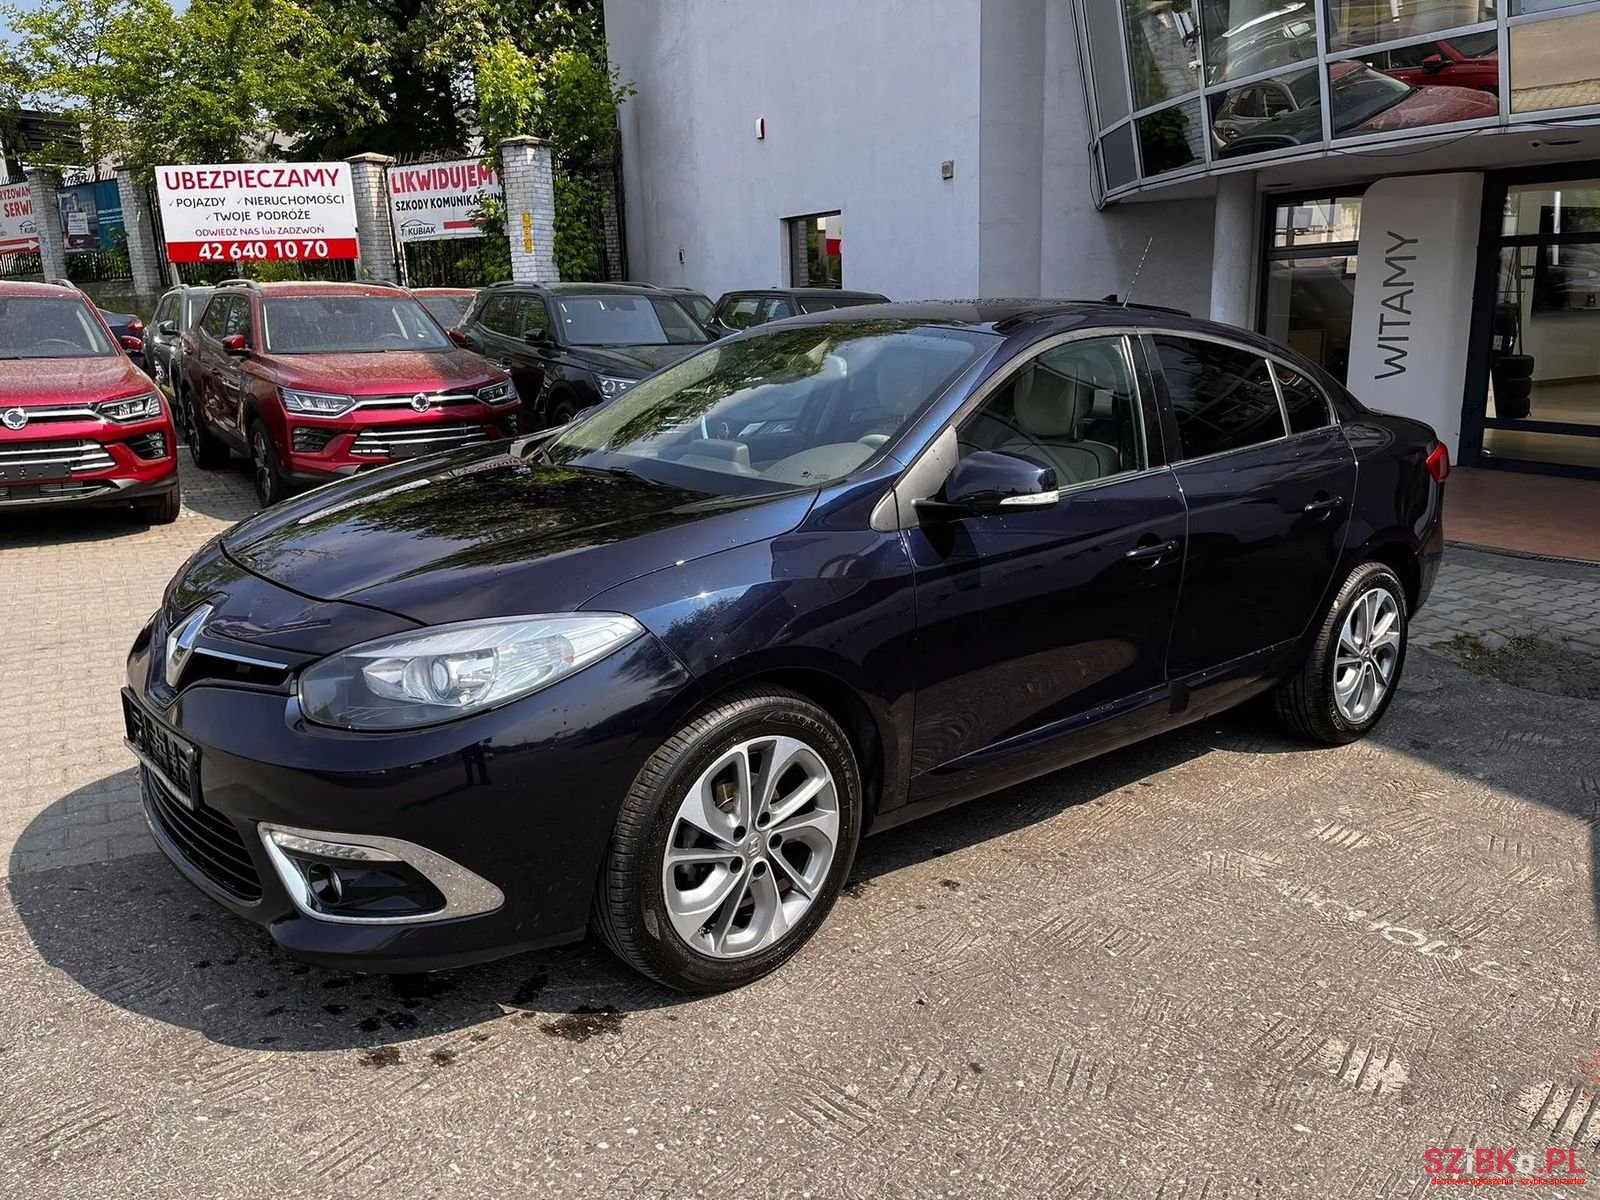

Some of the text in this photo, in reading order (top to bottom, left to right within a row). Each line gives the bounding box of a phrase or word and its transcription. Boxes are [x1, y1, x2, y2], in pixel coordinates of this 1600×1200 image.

[164, 168, 340, 190] UBEZPIECZAMY
[176, 193, 345, 209] POJAZDY NIERUCHOMOŚCI
[396, 198, 429, 212] SZKODY
[213, 208, 311, 223] TWOJE PODRÓŻE
[195, 224, 325, 237] ODWIEDŹ NAS lub ZADZWOŃ
[408, 226, 436, 236] KUBIAK
[198, 240, 328, 260] 42 640 10 70
[1374, 231, 1418, 380] WITAMY
